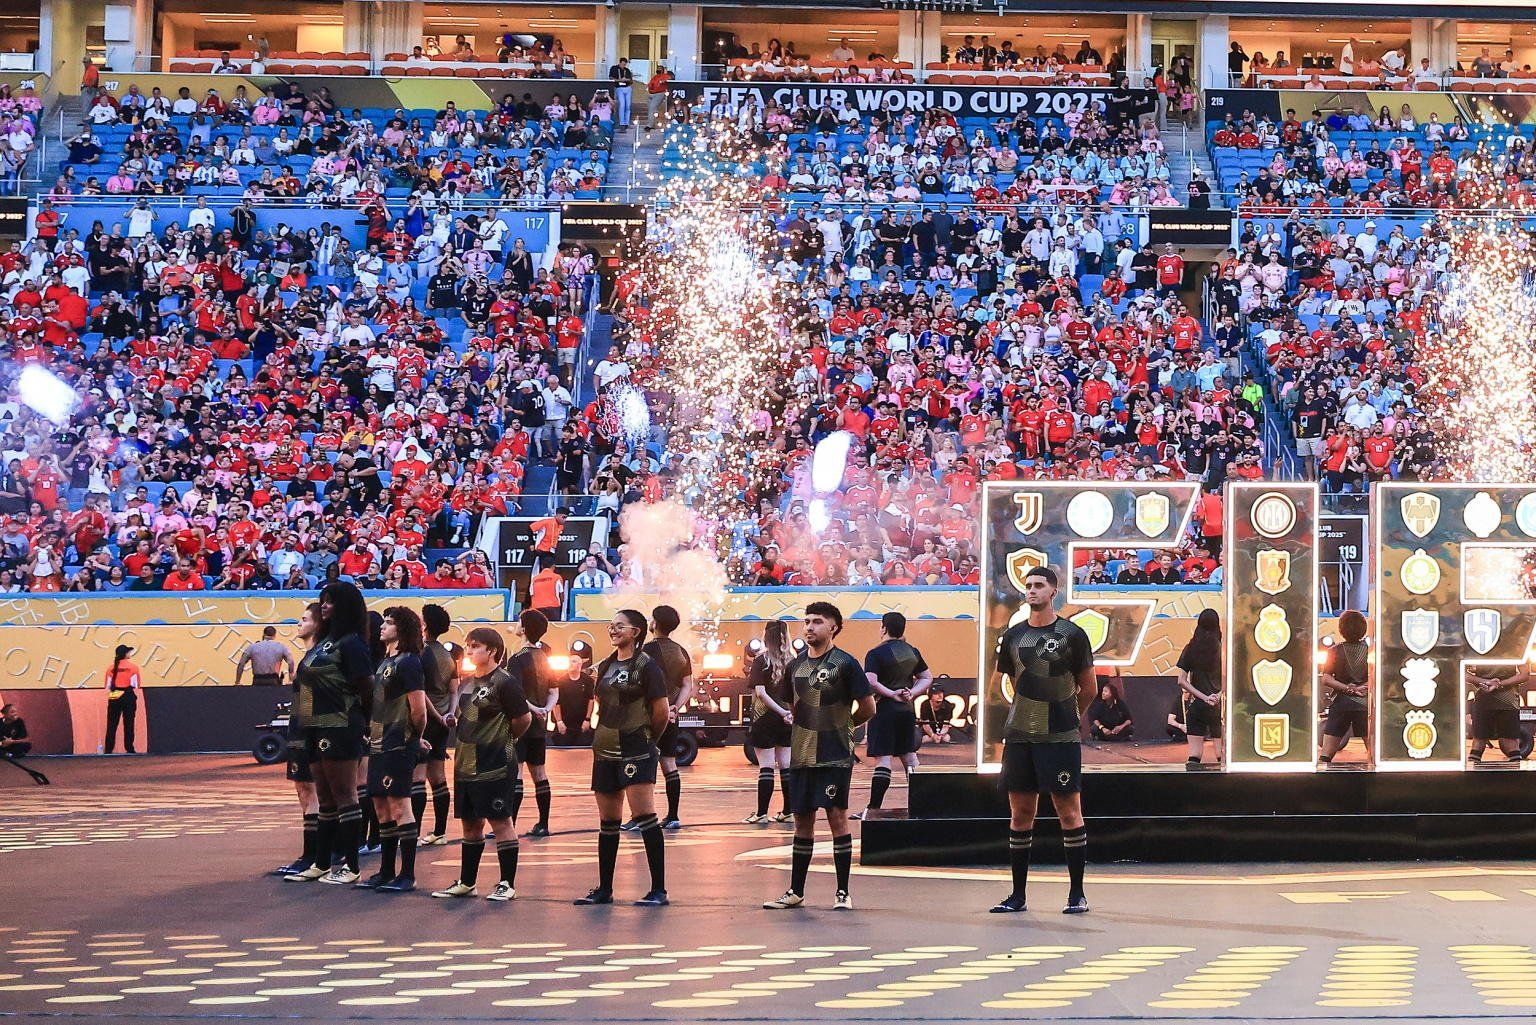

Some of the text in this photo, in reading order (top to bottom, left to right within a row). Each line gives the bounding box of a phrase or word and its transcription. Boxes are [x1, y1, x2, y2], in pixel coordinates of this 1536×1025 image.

[703, 87, 765, 111] FFA
[970, 91, 1029, 113] CUP
[1211, 96, 1224, 107] 219
[524, 217, 545, 229] 117
[505, 549, 525, 564] 117
[1338, 545, 1357, 559] 119
